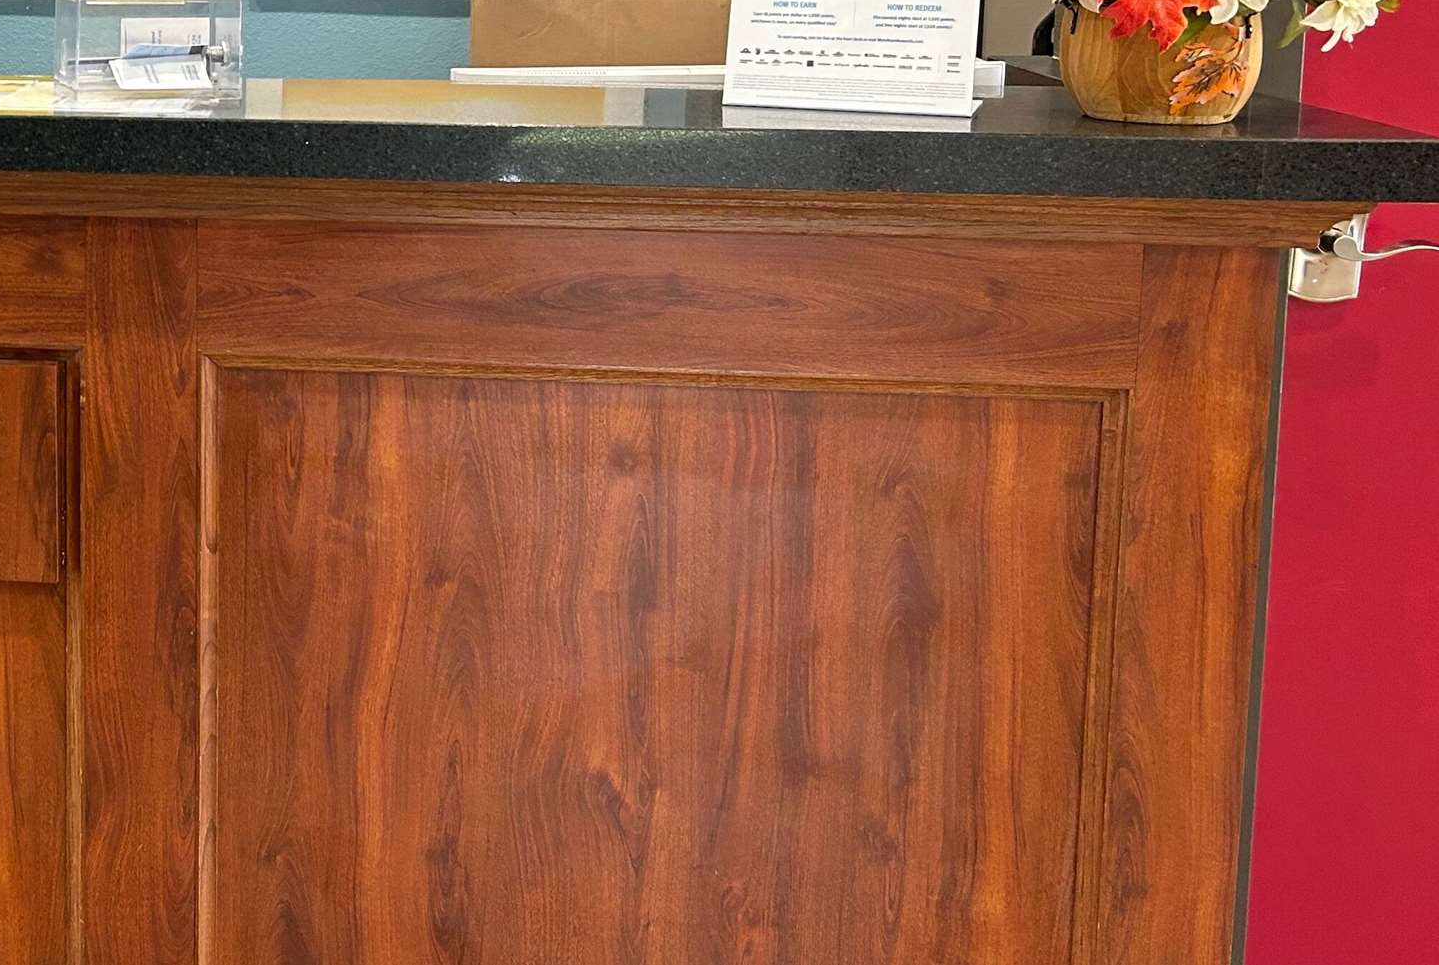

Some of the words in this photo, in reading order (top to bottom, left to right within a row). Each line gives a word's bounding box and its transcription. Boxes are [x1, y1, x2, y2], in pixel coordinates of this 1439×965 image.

[773, 0, 789, 8] HOW
[887, 3, 904, 11] HOW
[905, 4, 914, 12] TO
[915, 4, 942, 12] REDEEM
